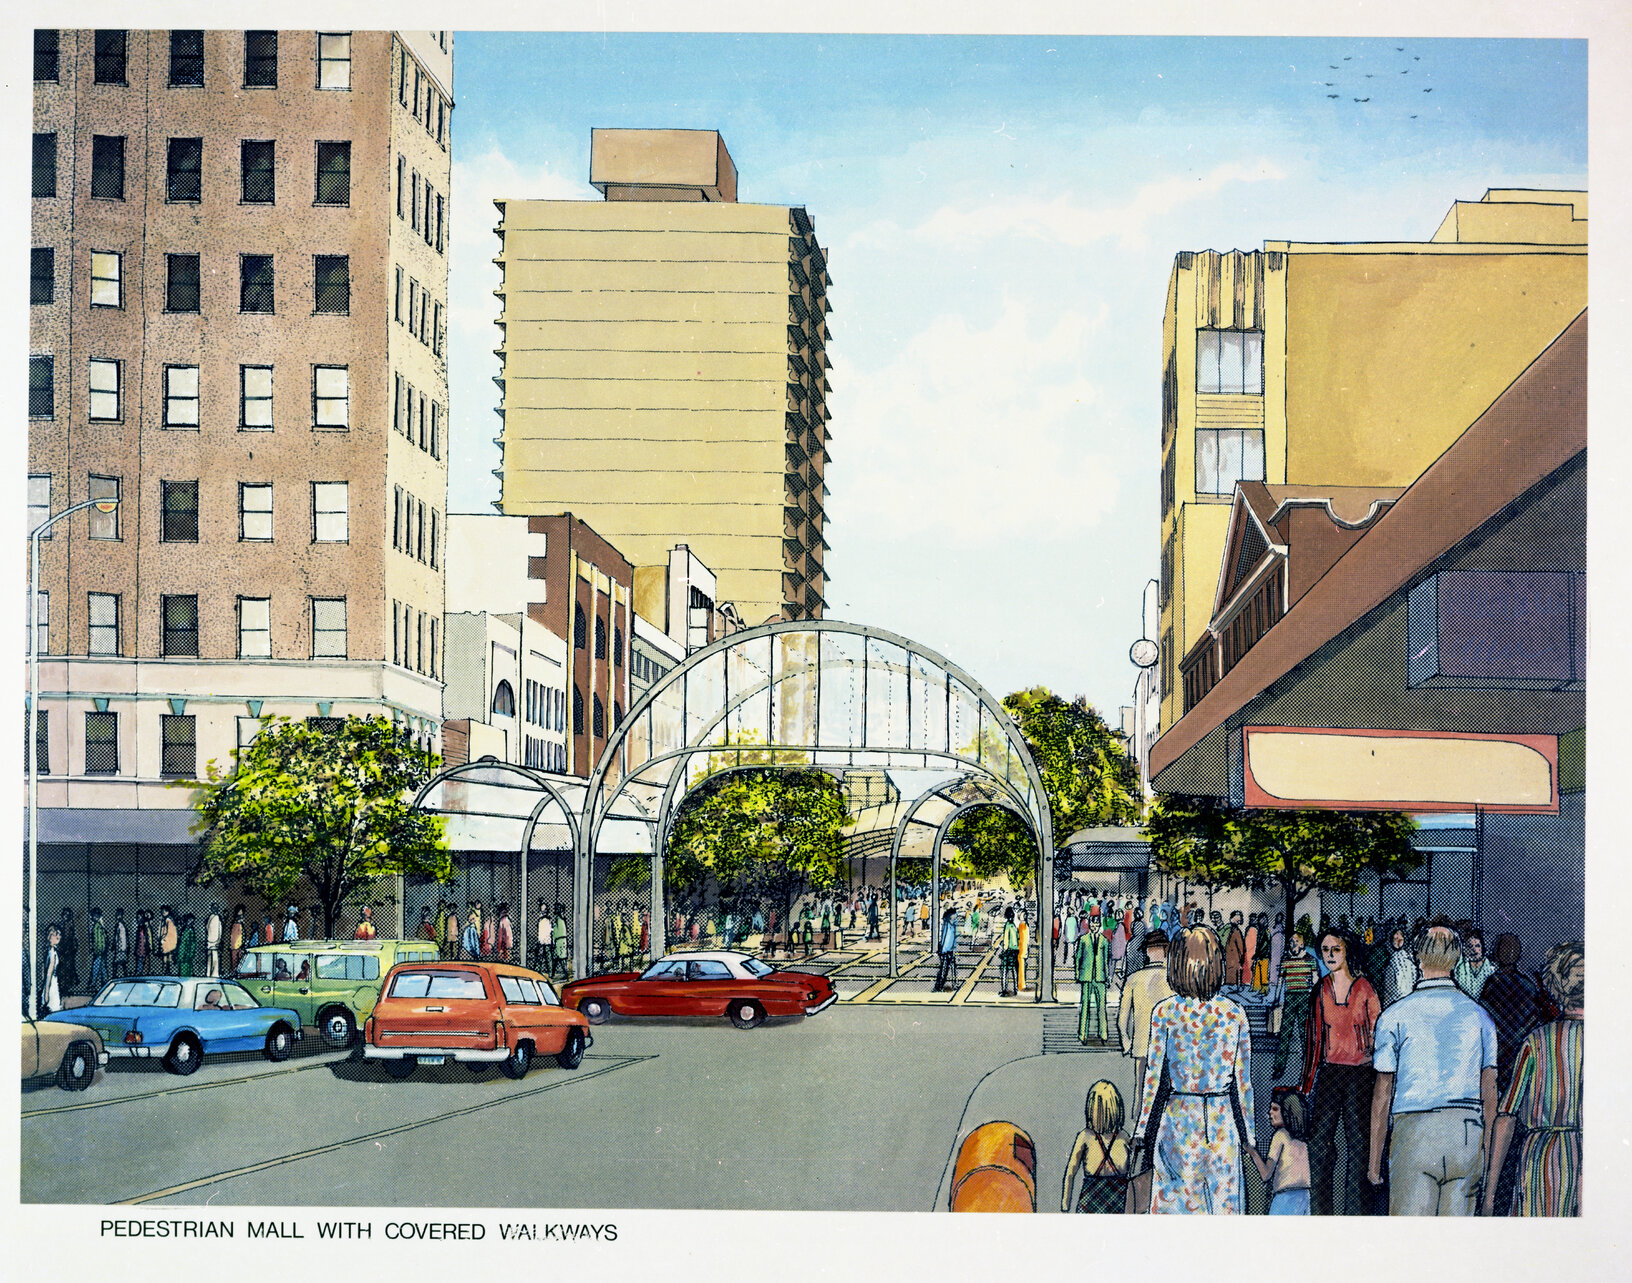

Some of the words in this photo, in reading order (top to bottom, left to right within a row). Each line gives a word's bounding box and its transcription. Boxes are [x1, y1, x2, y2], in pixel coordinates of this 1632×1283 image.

[101, 1220, 233, 1238] PEDESTRIAN
[247, 1221, 304, 1238] MALL
[317, 1222, 371, 1239] WITH
[384, 1222, 485, 1240] COVERED
[499, 1223, 618, 1241] WALKWAYS
